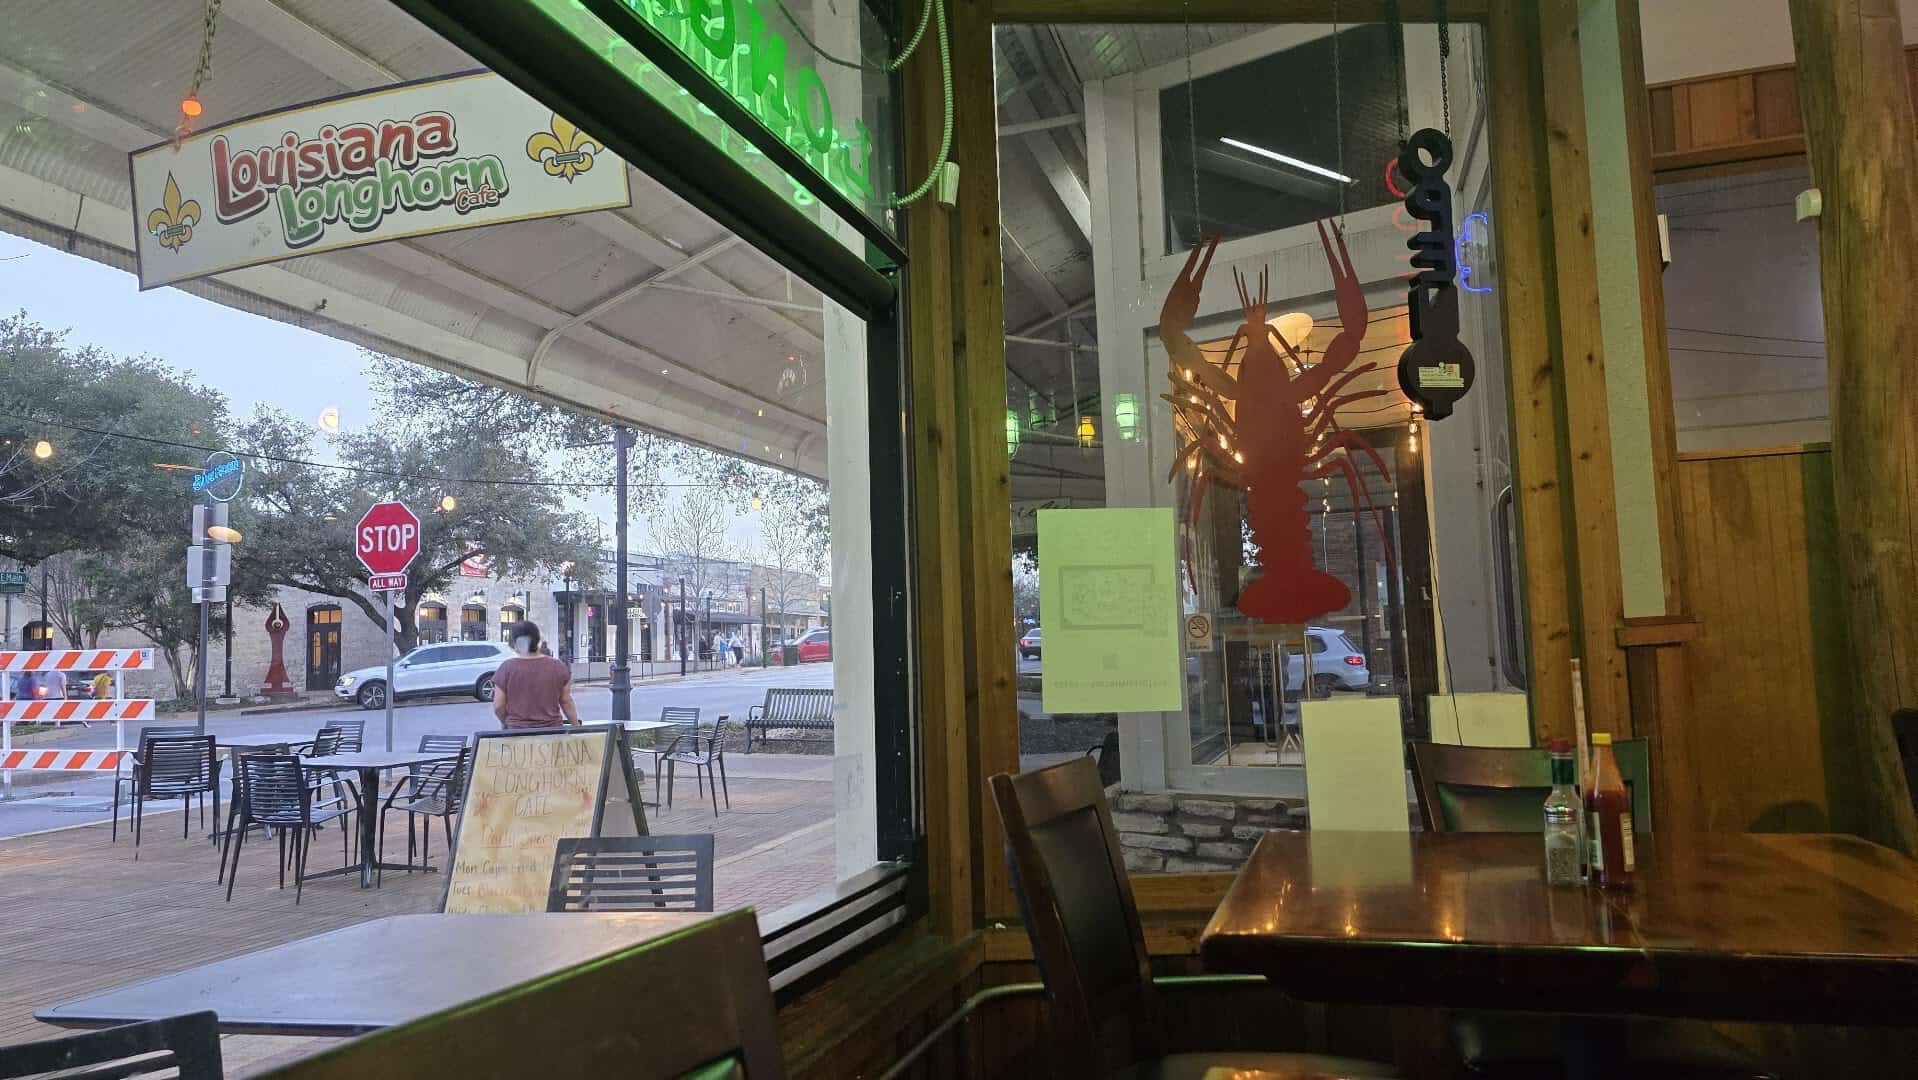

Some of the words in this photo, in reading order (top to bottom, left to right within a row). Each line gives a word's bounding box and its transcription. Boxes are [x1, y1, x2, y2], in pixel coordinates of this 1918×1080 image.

[212, 112, 456, 220] Louisiana
[277, 155, 507, 244] Longhorn
[455, 184, 499, 214] Cafe
[360, 523, 416, 553] STOP
[372, 578, 387, 589] ALL
[387, 576, 405, 588] WAY
[486, 739, 593, 769] LOUISIANA
[492, 766, 587, 795] LONGHORN
